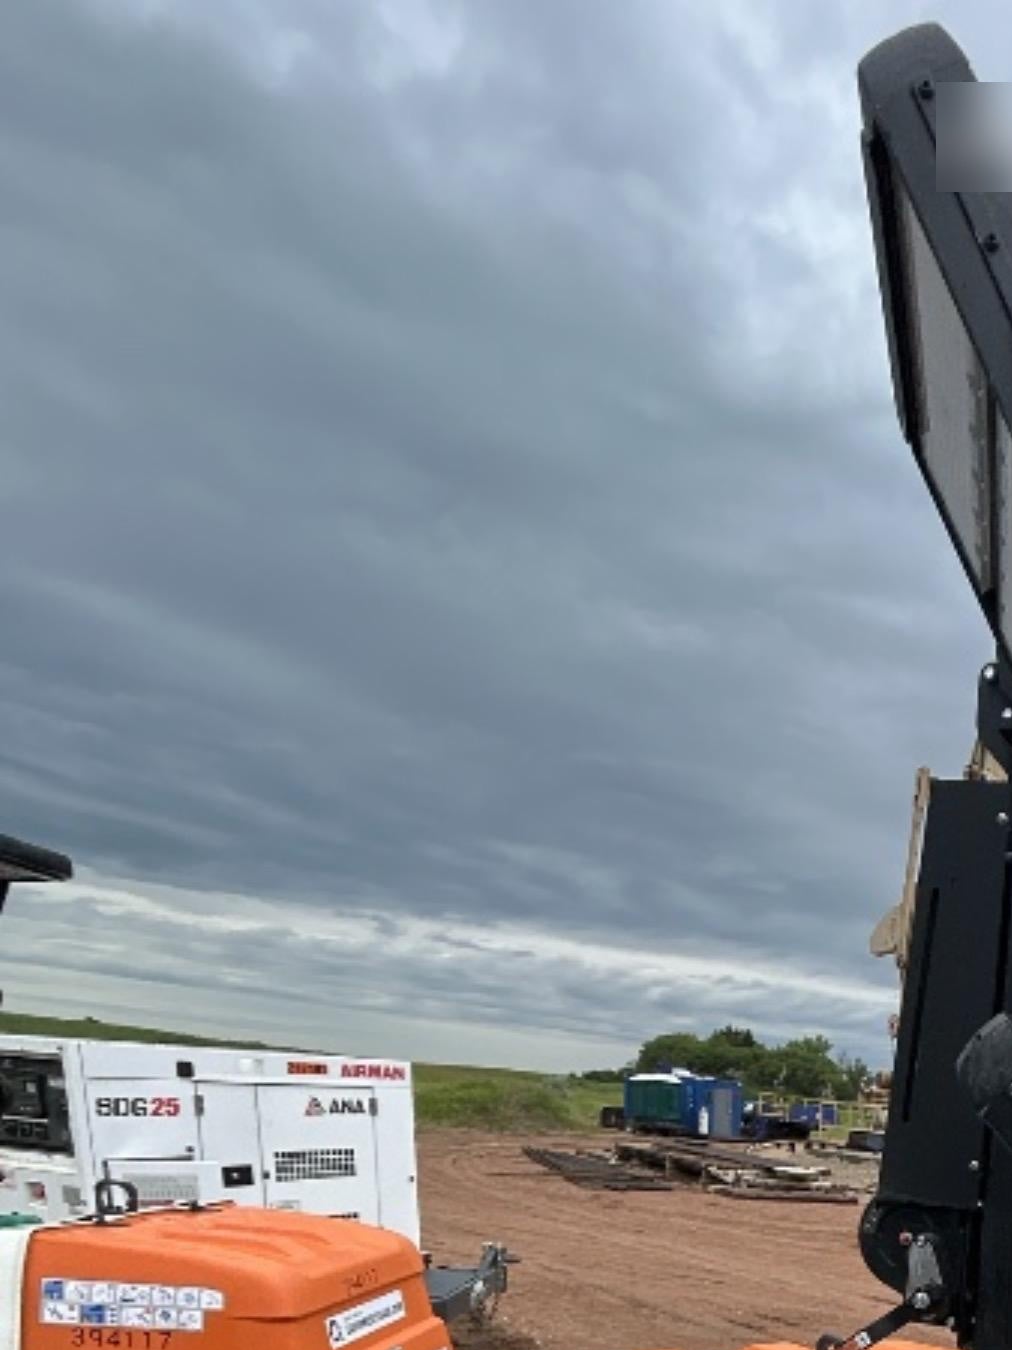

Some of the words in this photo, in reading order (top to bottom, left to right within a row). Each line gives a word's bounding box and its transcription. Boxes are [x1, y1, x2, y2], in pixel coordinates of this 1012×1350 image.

[341, 1064, 405, 1080] AIRMAN
[329, 1098, 366, 1114] ANA
[71, 1327, 172, 1350] 394117
